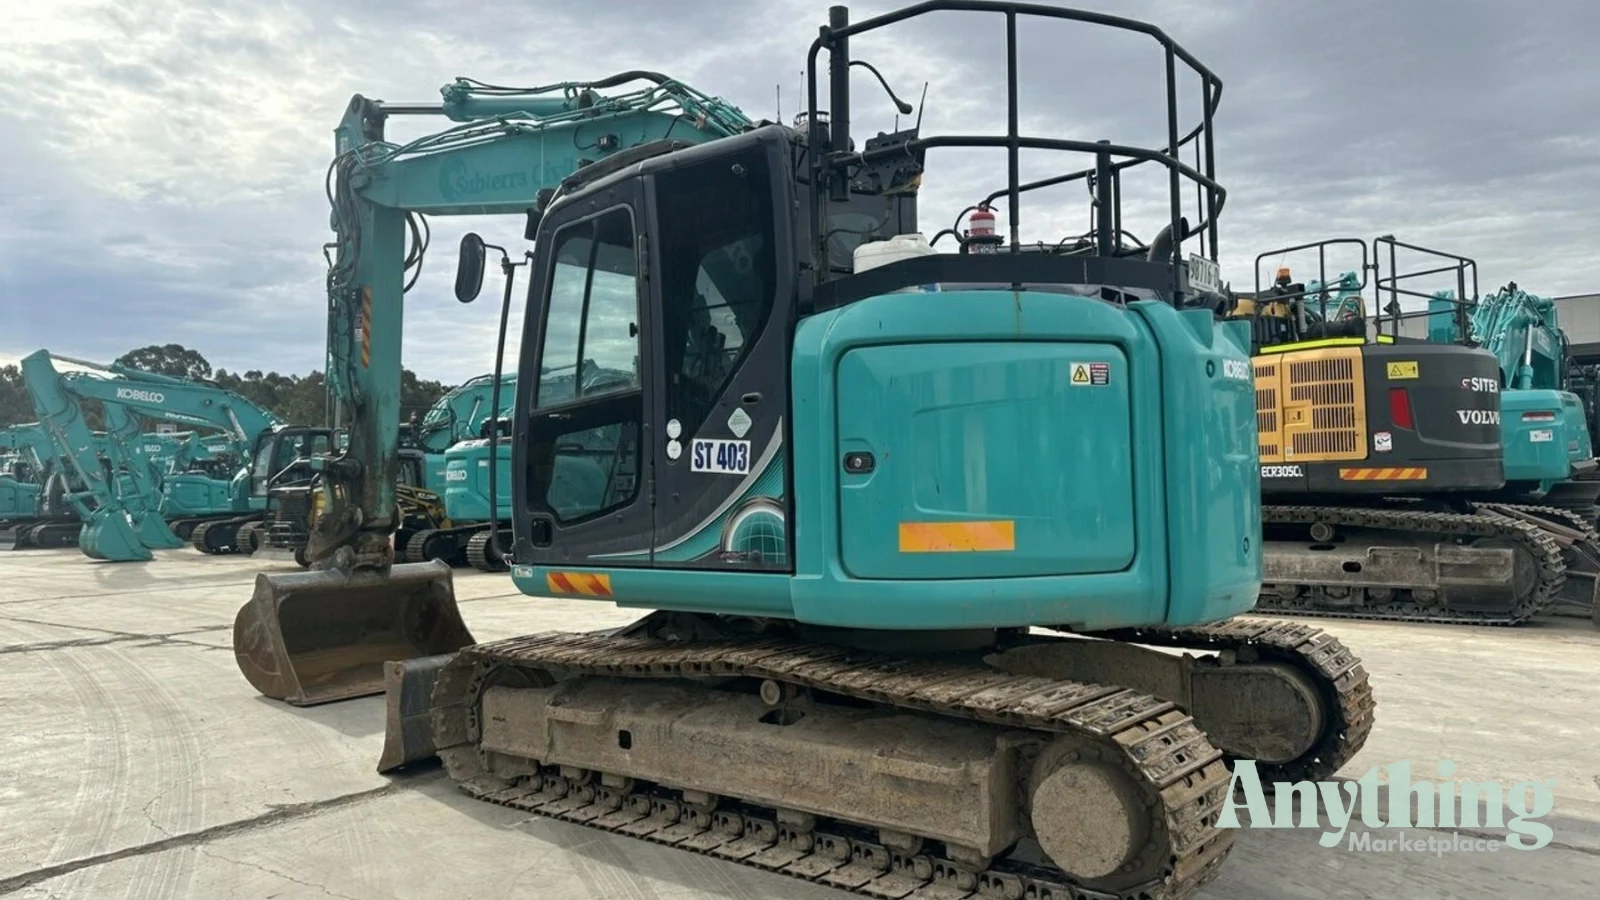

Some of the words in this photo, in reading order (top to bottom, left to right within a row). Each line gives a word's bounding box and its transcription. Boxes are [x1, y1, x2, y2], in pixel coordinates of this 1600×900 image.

[116, 387, 165, 404] KOBELCO
[694, 441, 714, 470] ST
[716, 442, 749, 472] 403
